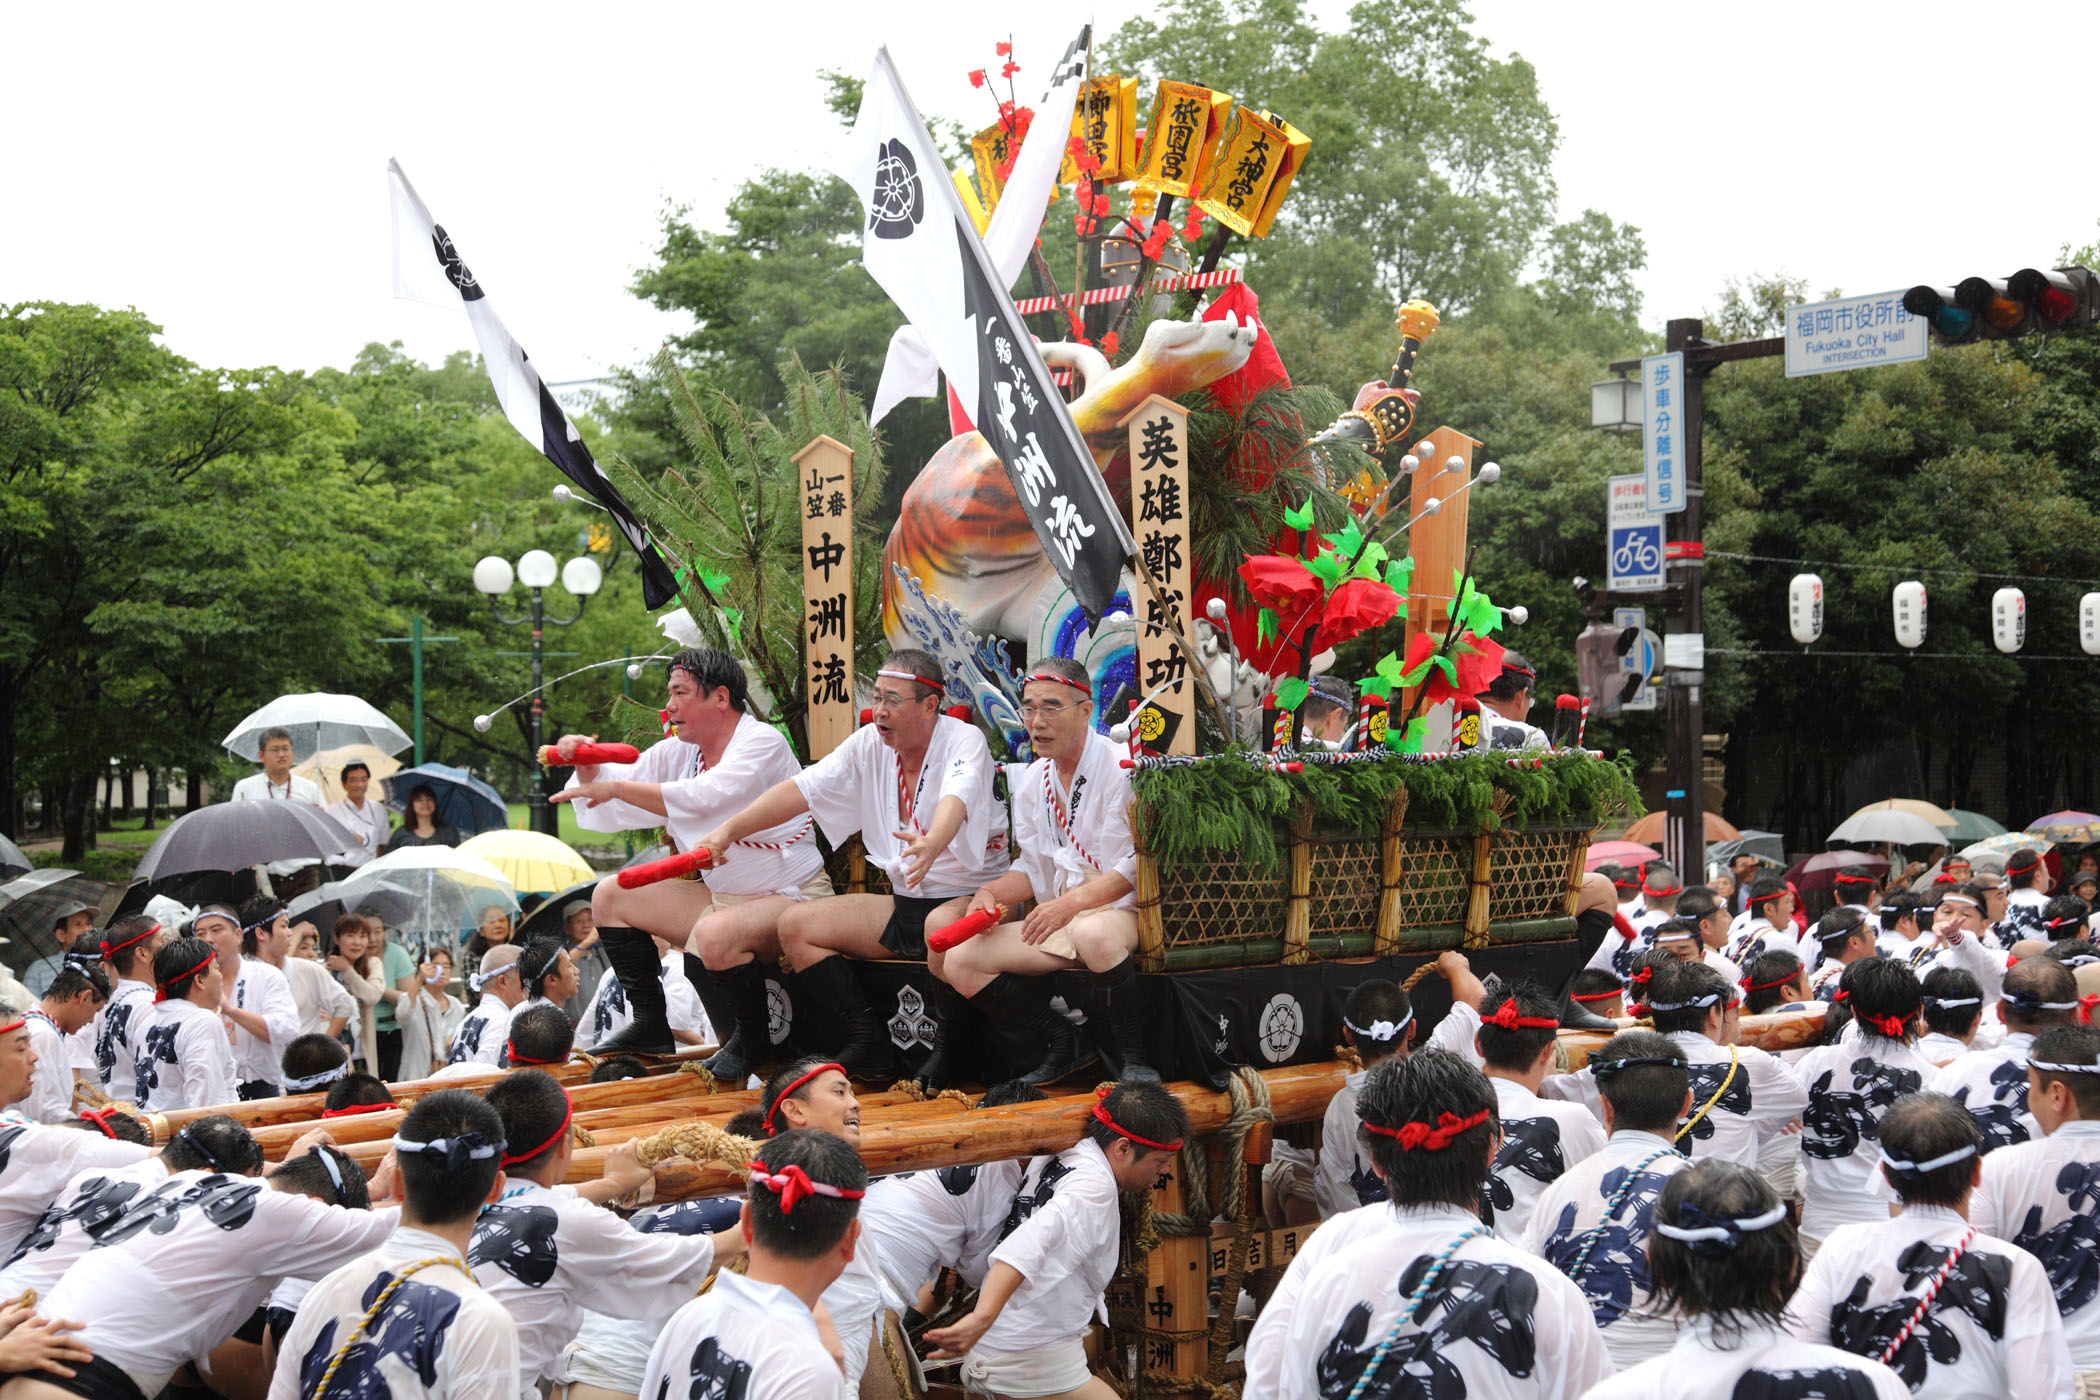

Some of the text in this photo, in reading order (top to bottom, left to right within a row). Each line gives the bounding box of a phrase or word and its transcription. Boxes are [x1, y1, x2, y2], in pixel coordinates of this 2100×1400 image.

[1226, 131, 1270, 211] 大神宮
[1806, 329, 1905, 354] Fukuoka City Hall
[1823, 347, 1886, 364] INTERSECTION
[1654, 364, 1672, 504] 歩車分離信号
[1139, 416, 1186, 695] 英雄鄭成功
[807, 532, 850, 706] 中洲流
